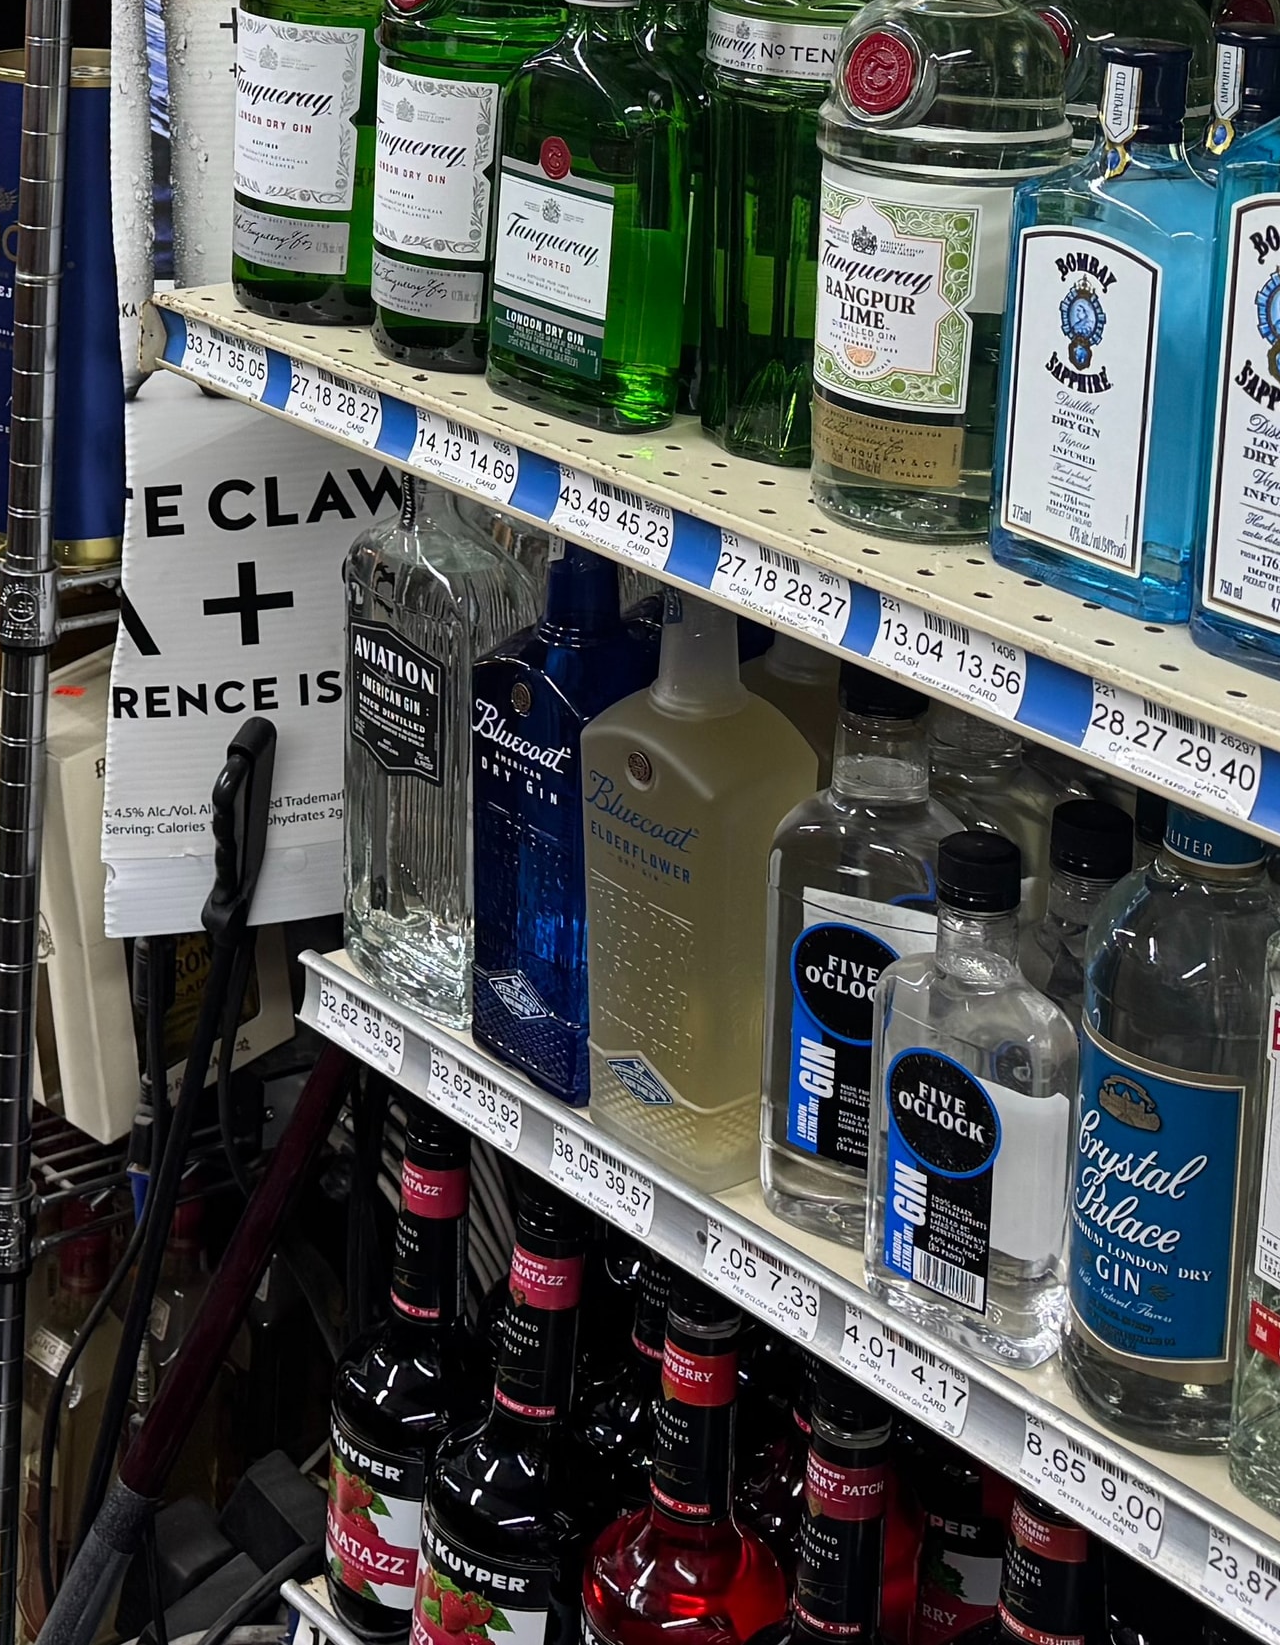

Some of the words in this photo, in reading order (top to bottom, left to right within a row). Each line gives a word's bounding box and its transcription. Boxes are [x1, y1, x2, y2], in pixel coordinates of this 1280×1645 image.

[790, 45, 835, 65] TEN
[1220, 50, 1234, 106] IMPORTED
[1112, 68, 1126, 126] IMPORTED
[820, 239, 934, 295] Tanqueray
[825, 275, 916, 317] RANGPUR
[186, 332, 222, 363] 33.71
[228, 350, 266, 381] 35.05
[418, 428, 461, 462] 14.13
[470, 447, 515, 484] 14.69
[208, 466, 401, 531] CLAW
[717, 552, 776, 592] 27.18
[784, 578, 847, 620] 28.27
[353, 633, 437, 695] AVIATION
[883, 618, 943, 662] 13.04
[956, 648, 1022, 695] 13.56
[472, 697, 571, 774] Bluecoat
[1091, 702, 1168, 752] 28.27
[1176, 738, 1256, 791] 29.40
[105, 821, 154, 836] Serving:
[157, 819, 205, 834] Calories
[827, 954, 880, 987] FIVE
[320, 990, 358, 1025] 32.62
[363, 1014, 402, 1054] 33.92
[431, 1059, 472, 1099] 32.62
[478, 1089, 519, 1129] 33.92
[799, 1037, 837, 1099] GIN
[918, 1082, 968, 1112] FIVE
[898, 1088, 987, 1145] O'CLOCK
[554, 1136, 599, 1179] 38.05
[605, 1167, 651, 1211] 39.57
[1078, 1108, 1208, 1202] Crystal
[1076, 1165, 1183, 1255] Palace
[709, 1232, 759, 1280] 7.05
[769, 1268, 819, 1318] 7.33
[845, 1322, 898, 1367] 4.01
[909, 1361, 969, 1409] 4.17
[1026, 1432, 1087, 1485] 8.65
[1101, 1474, 1163, 1532] 9.00
[1208, 1545, 1278, 1601] 23.87
